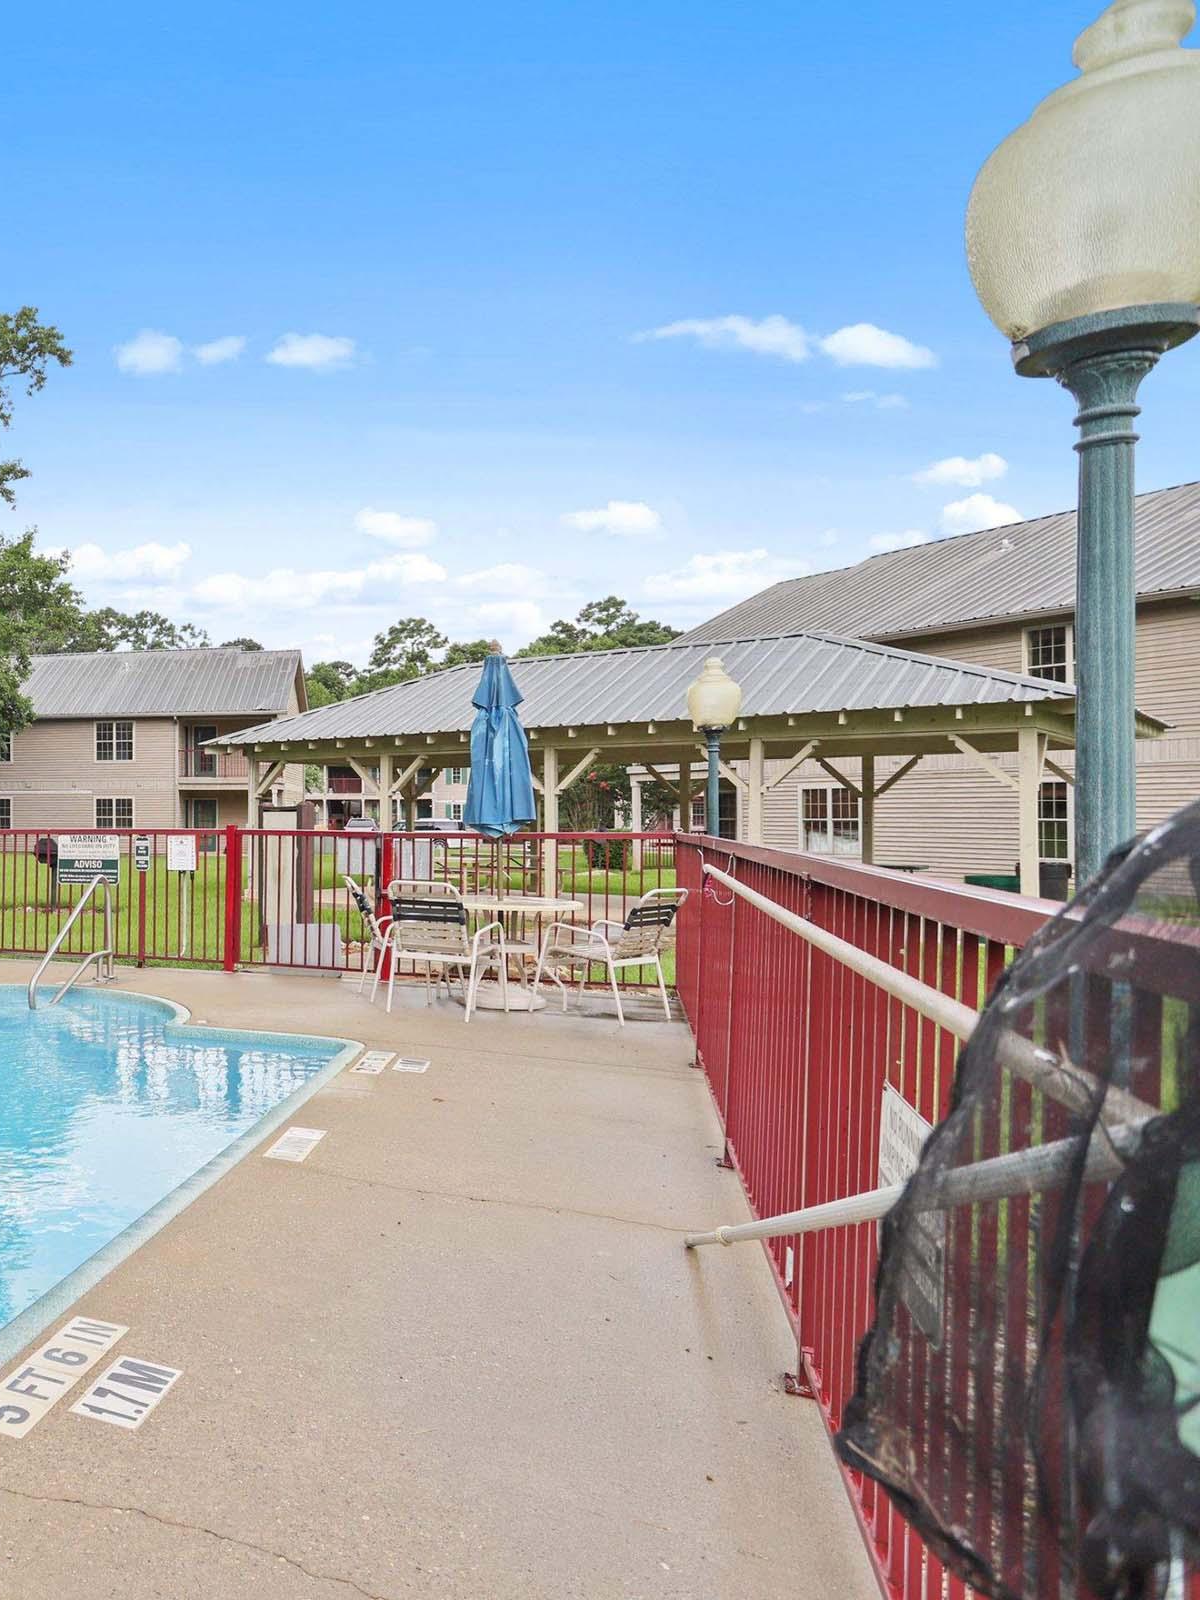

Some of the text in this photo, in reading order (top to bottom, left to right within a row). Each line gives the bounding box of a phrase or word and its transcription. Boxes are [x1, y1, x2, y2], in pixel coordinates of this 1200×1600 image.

[70, 835, 107, 843] WARNING
[73, 860, 103, 869] ADVISO
[63, 1320, 118, 1346] IN
[43, 1347, 88, 1366] 6
[6, 1366, 65, 1401] FT
